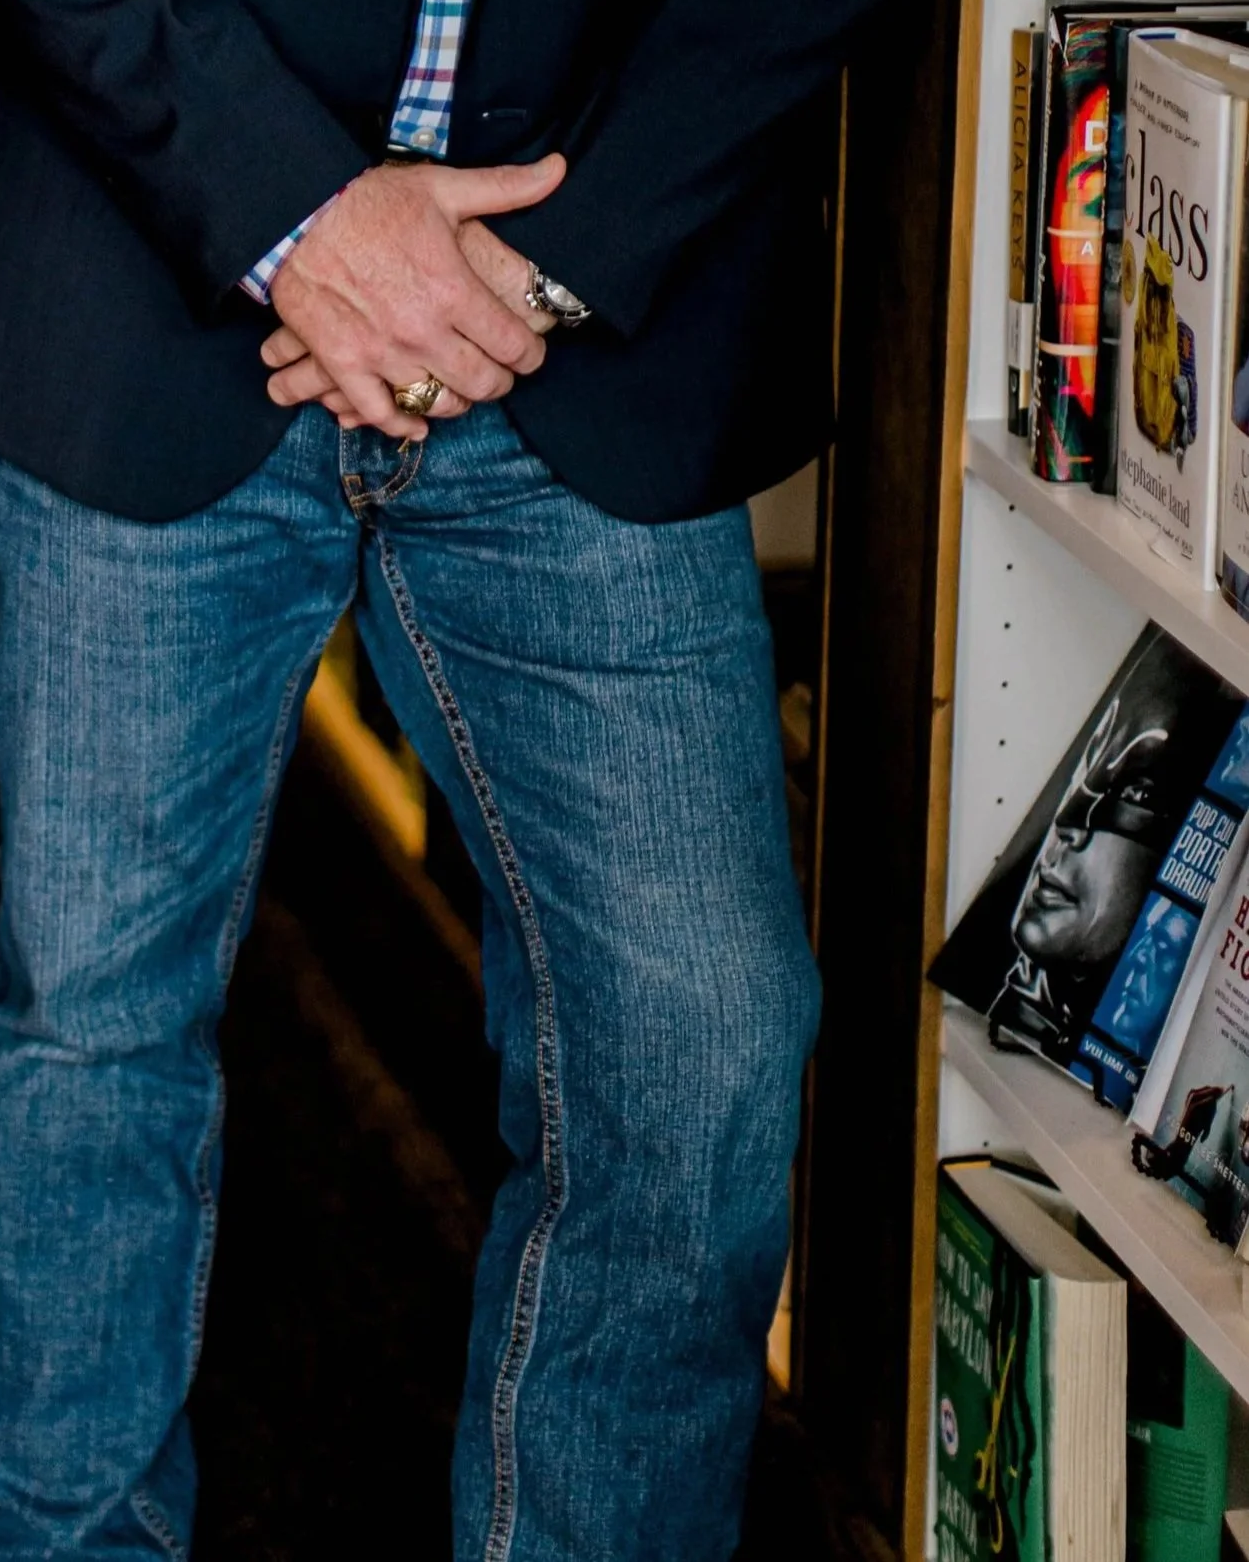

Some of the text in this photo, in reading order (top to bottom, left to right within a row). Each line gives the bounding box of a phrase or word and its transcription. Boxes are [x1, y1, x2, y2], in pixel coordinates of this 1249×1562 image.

[1010, 58, 1027, 270] ALICIA KEYS
[1124, 128, 1209, 282] class
[1168, 483, 1190, 530] land
[1189, 800, 1219, 831] POP
[1235, 895, 1249, 931] H
